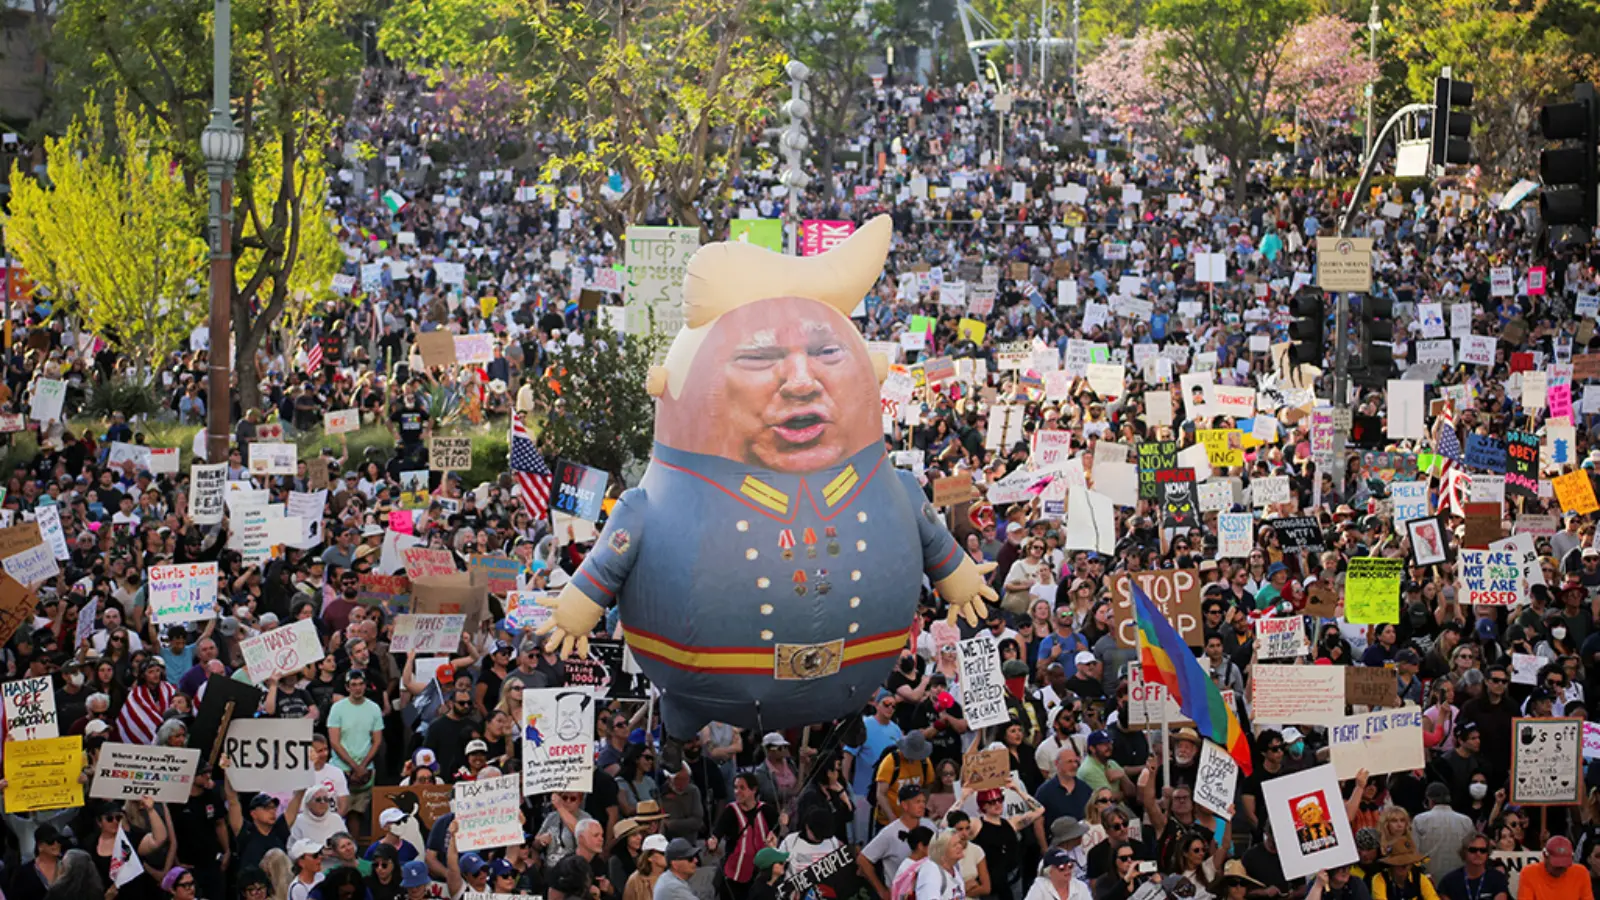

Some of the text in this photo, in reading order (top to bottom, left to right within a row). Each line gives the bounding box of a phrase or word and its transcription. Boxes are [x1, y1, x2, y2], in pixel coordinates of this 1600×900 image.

[1199, 432, 1224, 442] FUCK
[1507, 431, 1519, 442] DO
[1163, 442, 1175, 454] UP
[1508, 444, 1537, 462] OBEY
[436, 456, 469, 468] GTFO!
[1139, 455, 1176, 469] NOW
[1517, 461, 1529, 472] IN
[1140, 472, 1155, 482] OR
[559, 482, 596, 501] PROJECT
[1393, 486, 1425, 497] MELT
[1396, 503, 1426, 520] ICE
[1220, 513, 1252, 532] RESIST
[1272, 518, 1317, 529] CONGRESS
[1461, 552, 1517, 566] WE ARE
[151, 565, 215, 581] Girls Just
[1463, 565, 1484, 577] NOT
[1115, 571, 1195, 609] STOP
[1466, 579, 1517, 591] WE ARE
[171, 588, 200, 603] FUN
[1470, 591, 1518, 605] PISSED
[959, 637, 996, 659] WE THE
[565, 664, 593, 675] Taking
[963, 654, 996, 677] PEOPLE
[4, 677, 49, 697] HANDS
[969, 672, 991, 689] HAVE
[14, 691, 43, 707] OFF
[963, 684, 1002, 706] ENTERED
[19, 703, 43, 716] OUR
[964, 700, 1002, 721] THE CHAT
[7, 711, 57, 731] DEMOCRACY
[1333, 711, 1422, 744] FIGHT FOR PEOPLE
[227, 737, 312, 771] RESIST
[549, 744, 588, 757] DEPORT
[111, 752, 188, 765] When Injustice
[113, 761, 181, 773] becomes LAW
[100, 768, 190, 784] RESISTANCE
[122, 785, 161, 796] DUTY
[462, 783, 482, 798] TAX
[788, 869, 813, 893] THE
[811, 844, 854, 882] PEOPLE
